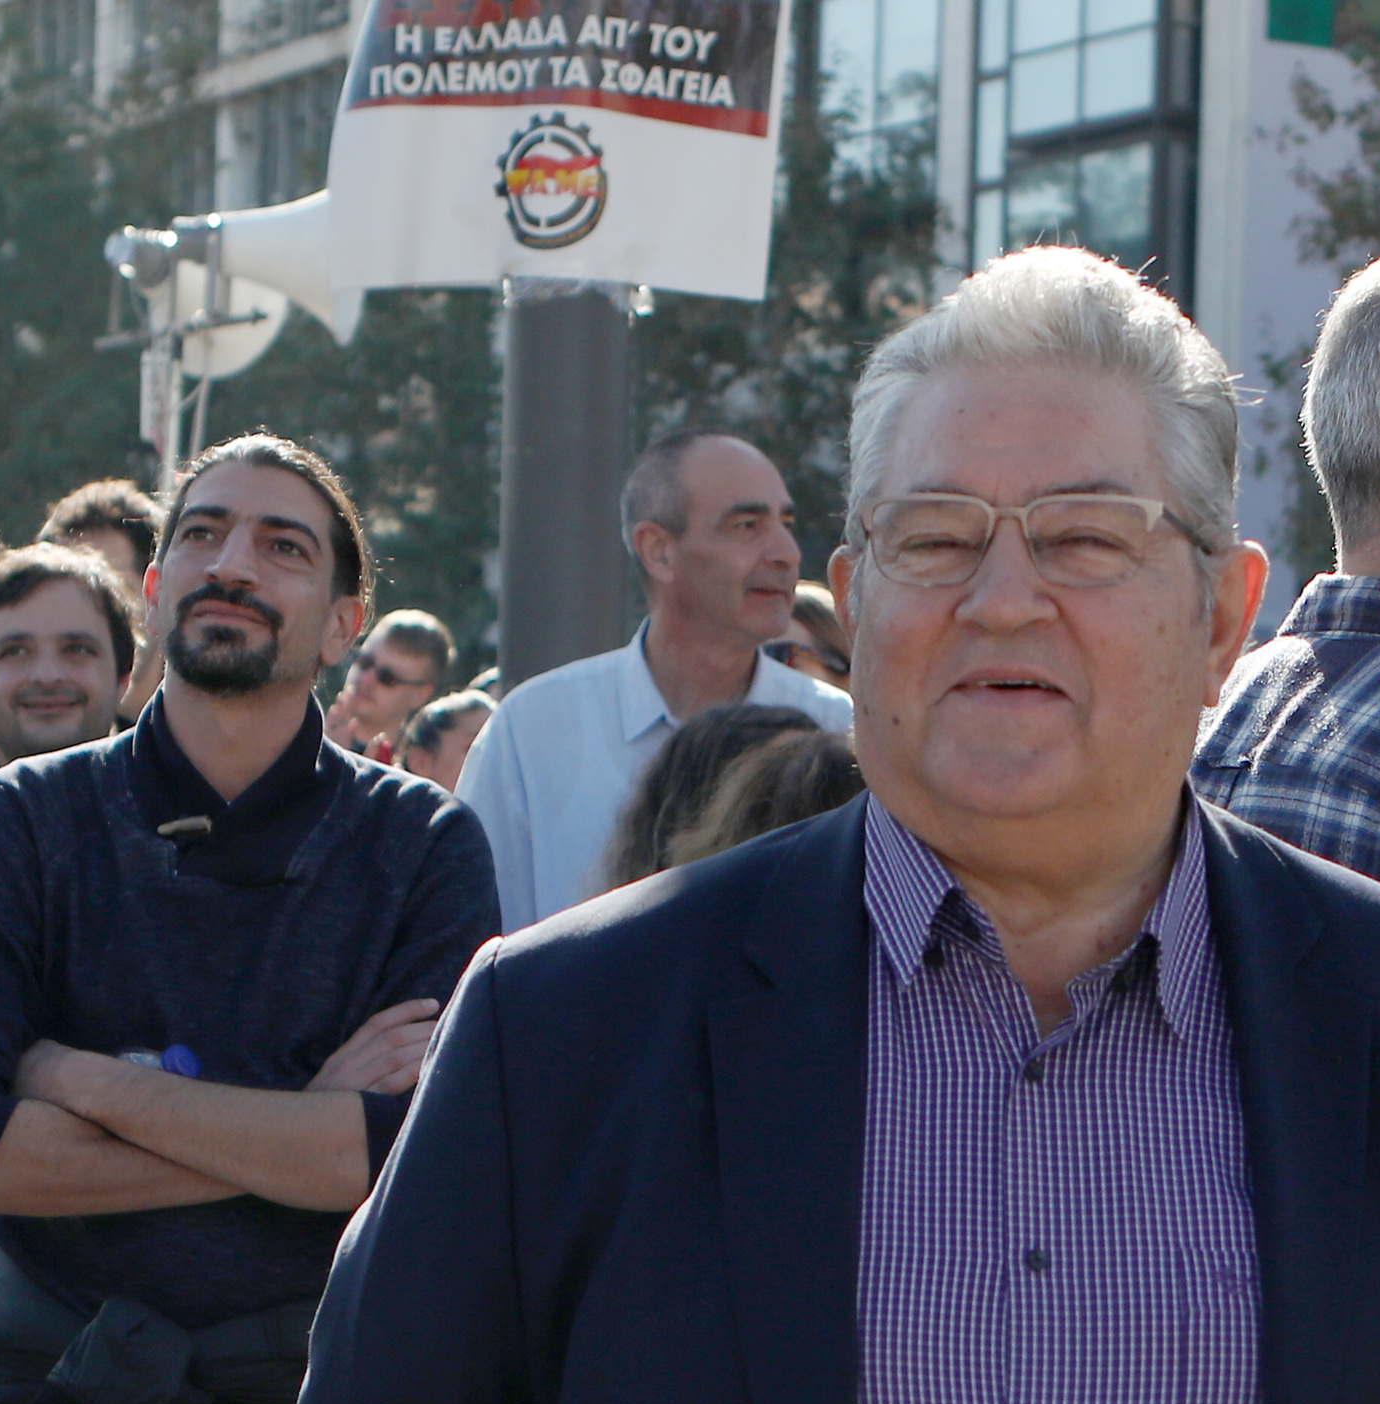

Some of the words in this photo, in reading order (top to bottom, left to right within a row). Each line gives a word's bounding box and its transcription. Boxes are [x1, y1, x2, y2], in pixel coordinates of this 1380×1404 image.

[395, 23, 421, 53] Η
[434, 14, 568, 55] ΕΛΛΑΔΑ
[649, 23, 718, 63] ΤΟΥ
[370, 56, 541, 97] ΠΟΛΕΜΟΥ
[548, 55, 591, 88] ΤΑ
[599, 57, 736, 108] ΣΦΑΓΕΙΑ
